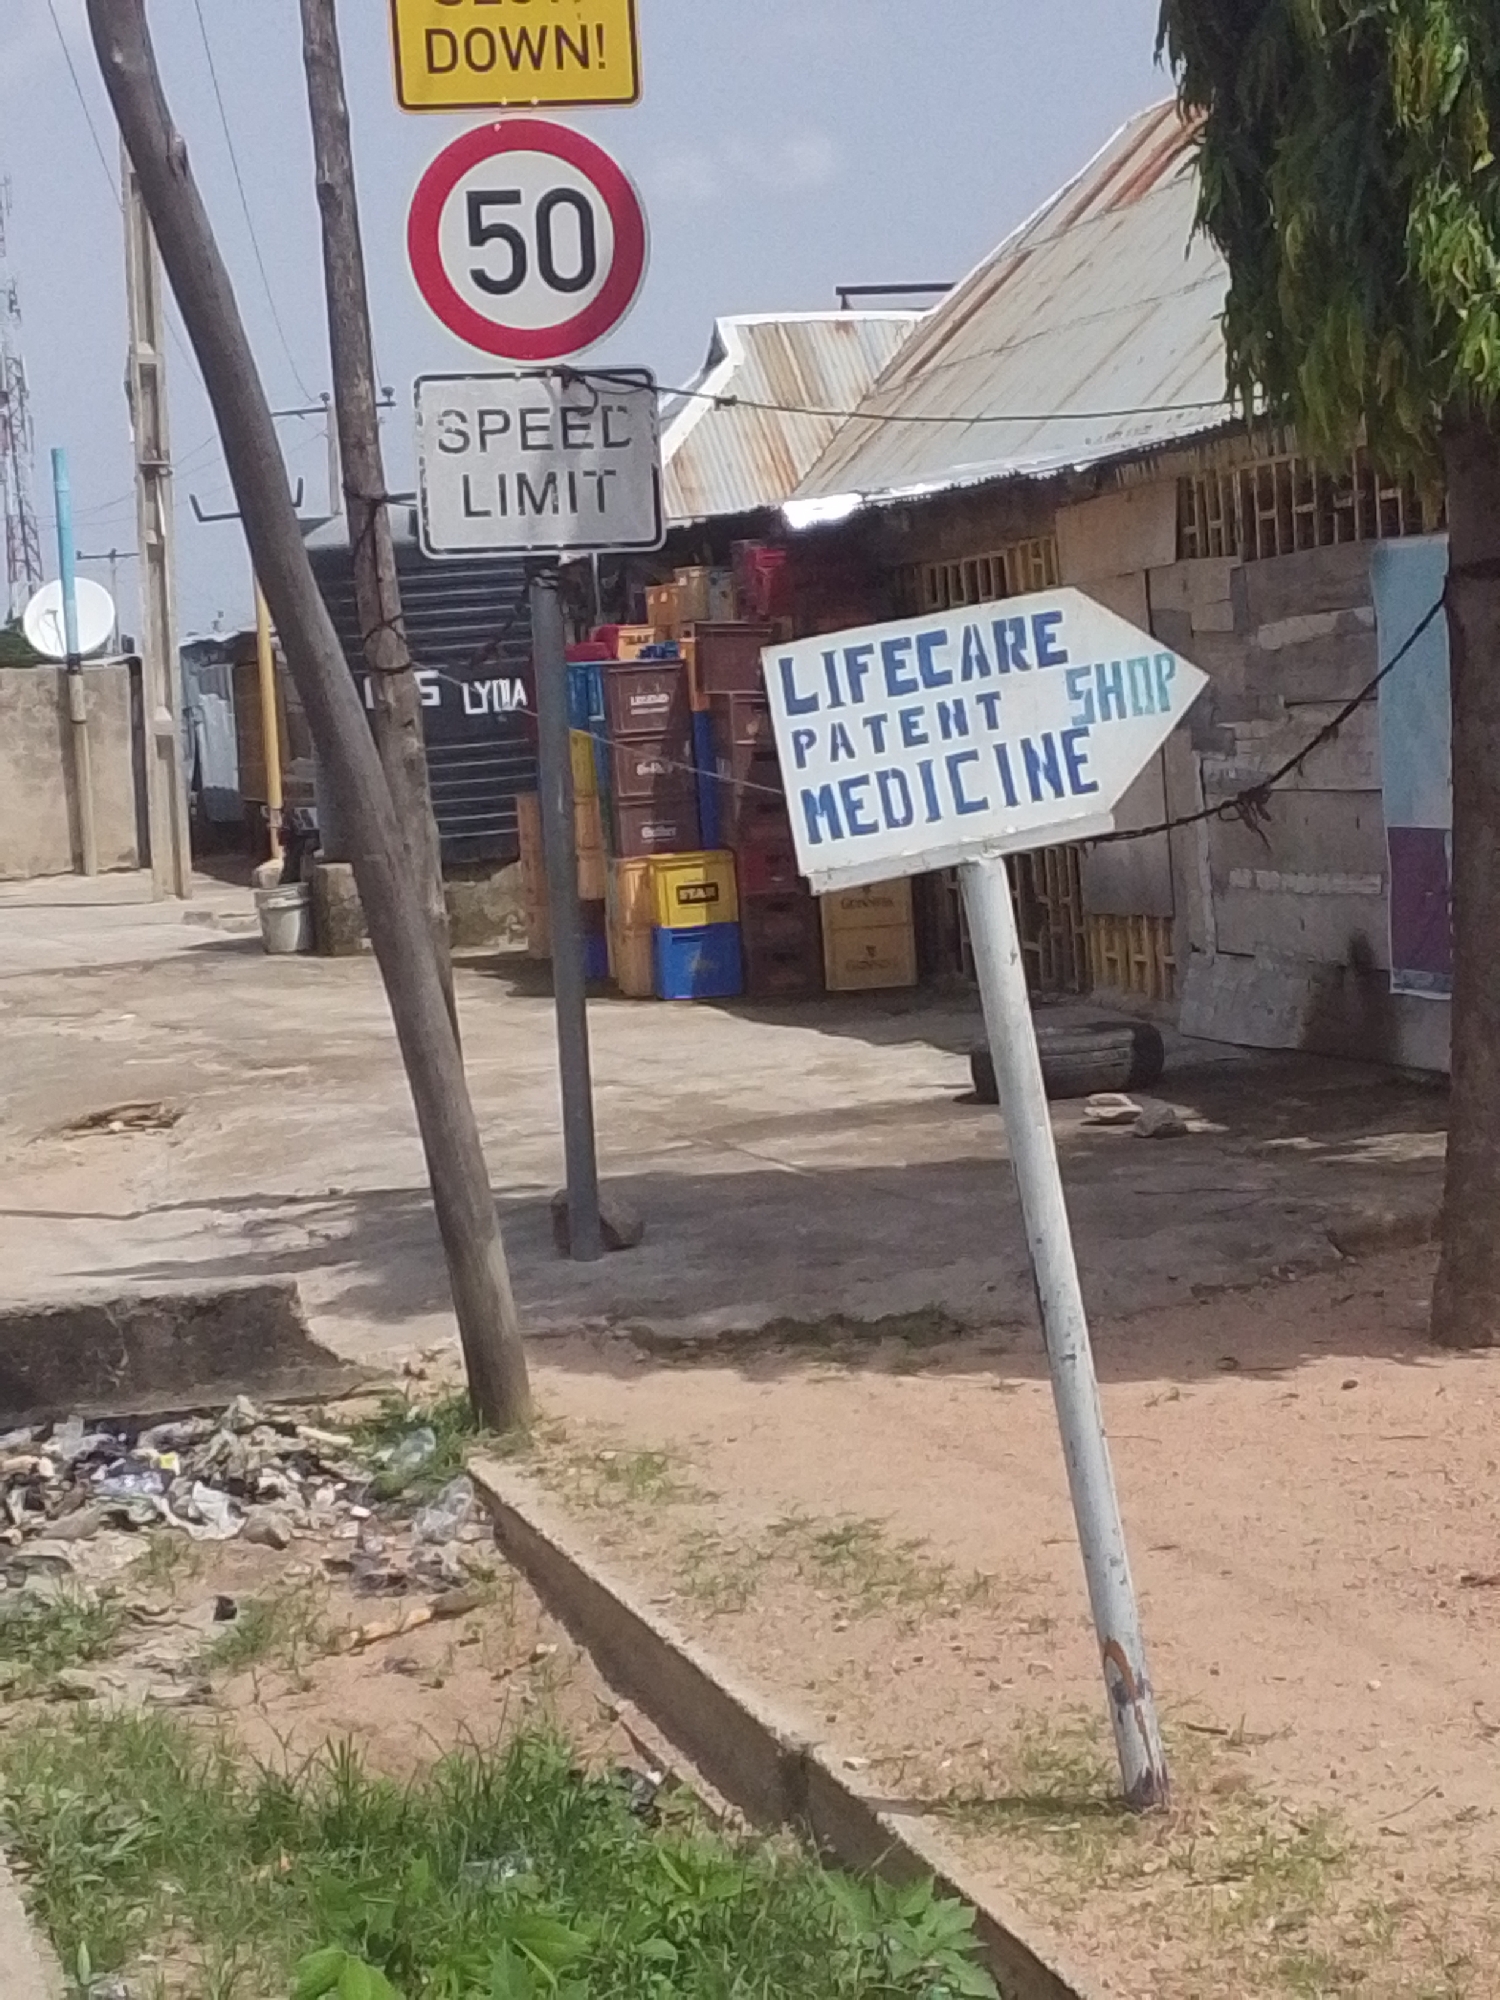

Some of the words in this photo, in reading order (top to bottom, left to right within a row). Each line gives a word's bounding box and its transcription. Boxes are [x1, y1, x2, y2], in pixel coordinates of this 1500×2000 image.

[425, 23, 606, 74] DOWN!
[466, 187, 596, 295] 50
[437, 406, 632, 454] SPEED
[463, 469, 616, 517] LIMIT
[778, 610, 1068, 716] LIFECARE
[1065, 652, 1175, 726] SHOP
[790, 691, 1002, 769] PATENT
[800, 727, 1099, 845] MEDICINE
